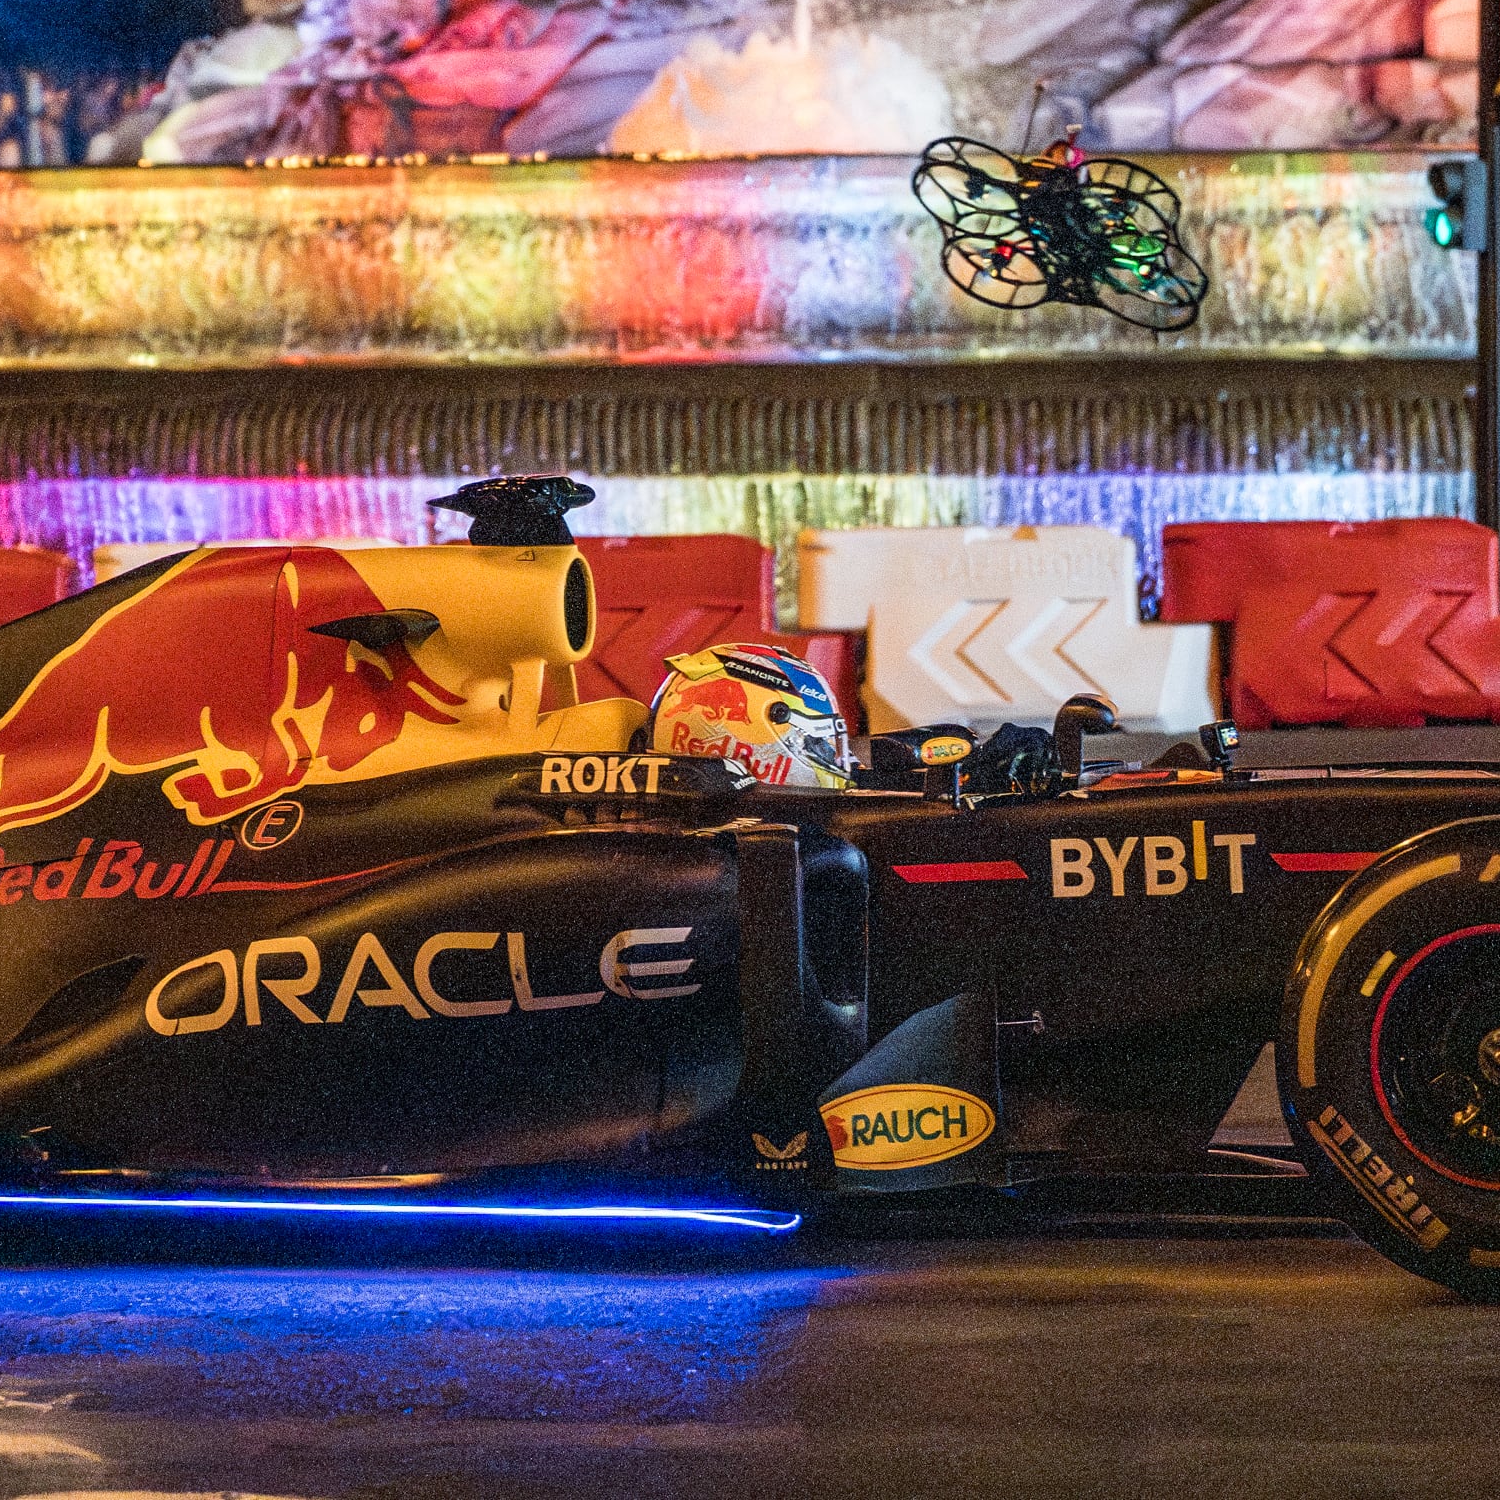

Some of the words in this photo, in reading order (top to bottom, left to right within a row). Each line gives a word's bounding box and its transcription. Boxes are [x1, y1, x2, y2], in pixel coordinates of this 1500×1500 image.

[540, 756, 671, 794] ROKT
[672, 721, 731, 757] Red
[730, 741, 793, 786] Bull
[81, 838, 236, 900] Bull
[1050, 820, 1257, 899] BYBIT
[145, 926, 702, 1036] ORACLE
[852, 1103, 968, 1146] RAUCH
